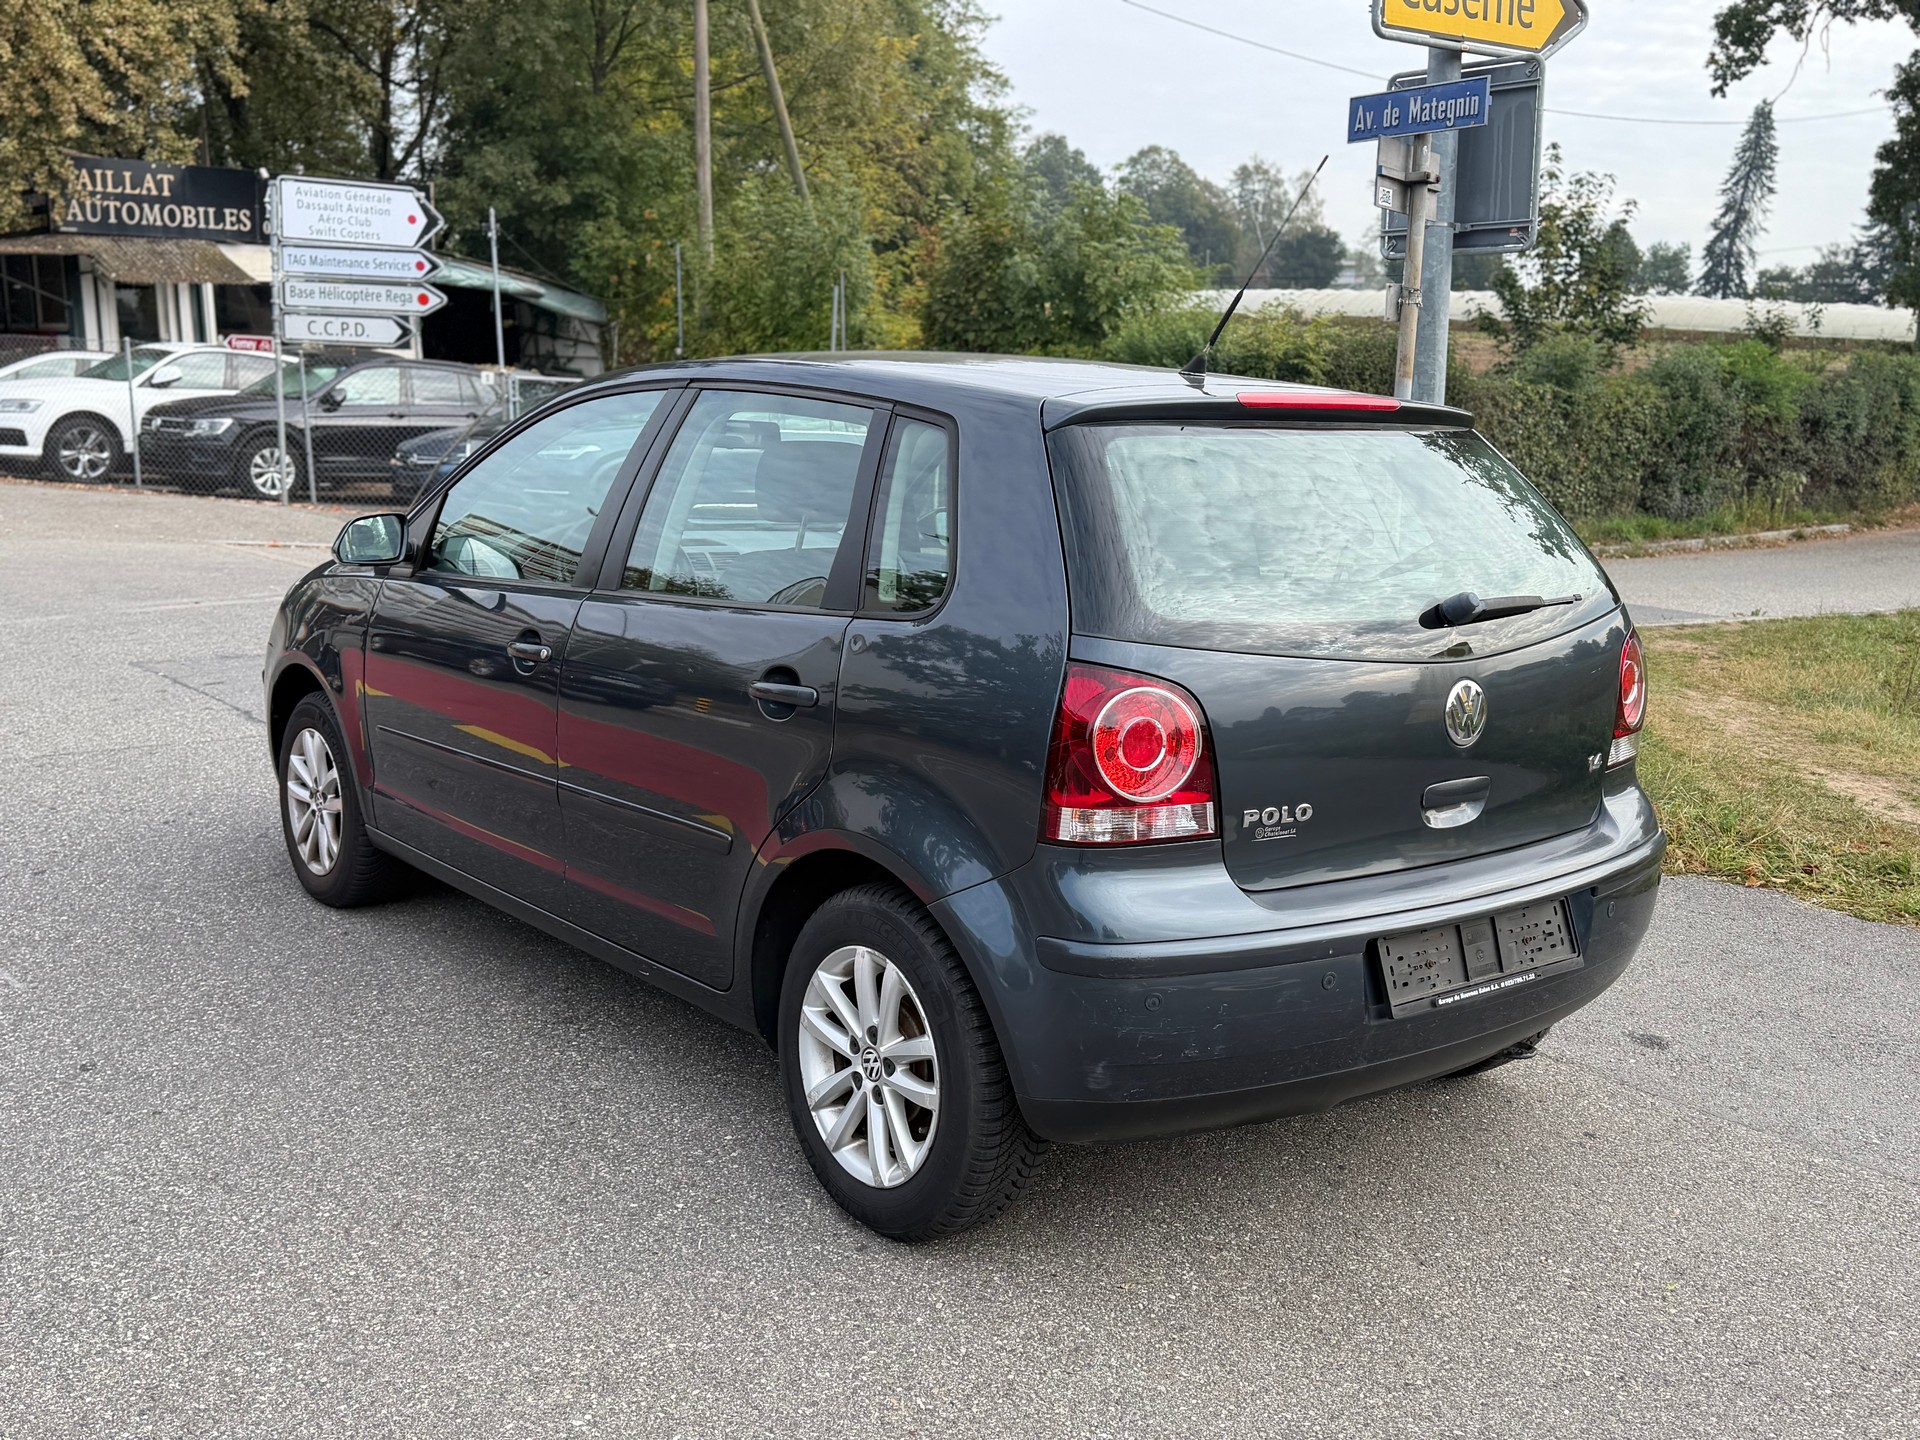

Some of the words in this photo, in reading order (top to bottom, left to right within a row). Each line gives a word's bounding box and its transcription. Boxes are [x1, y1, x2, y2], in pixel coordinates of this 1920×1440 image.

[1403, 0, 1535, 29] erne
[1354, 104, 1377, 132] Av.
[1383, 101, 1400, 128] de
[1408, 91, 1480, 126] Mategnin
[75, 168, 175, 197] AILLAT
[295, 186, 341, 201] Aviation
[344, 189, 392, 204] Générale
[66, 198, 252, 232] AUTOMOBILES
[296, 199, 343, 213] Dassault
[346, 203, 391, 216] Aviation
[318, 213, 372, 228] Aéro-Club
[308, 225, 337, 238] Swift
[340, 228, 381, 241] Copters
[287, 253, 306, 267] TAG
[309, 255, 370, 269] Maintenance
[372, 258, 412, 272] Services
[289, 285, 316, 299] Base
[318, 286, 382, 303] Hélicoptère
[385, 289, 414, 306] Rega
[307, 319, 370, 338] C.C.P.D.
[1242, 803, 1313, 828] POLO
